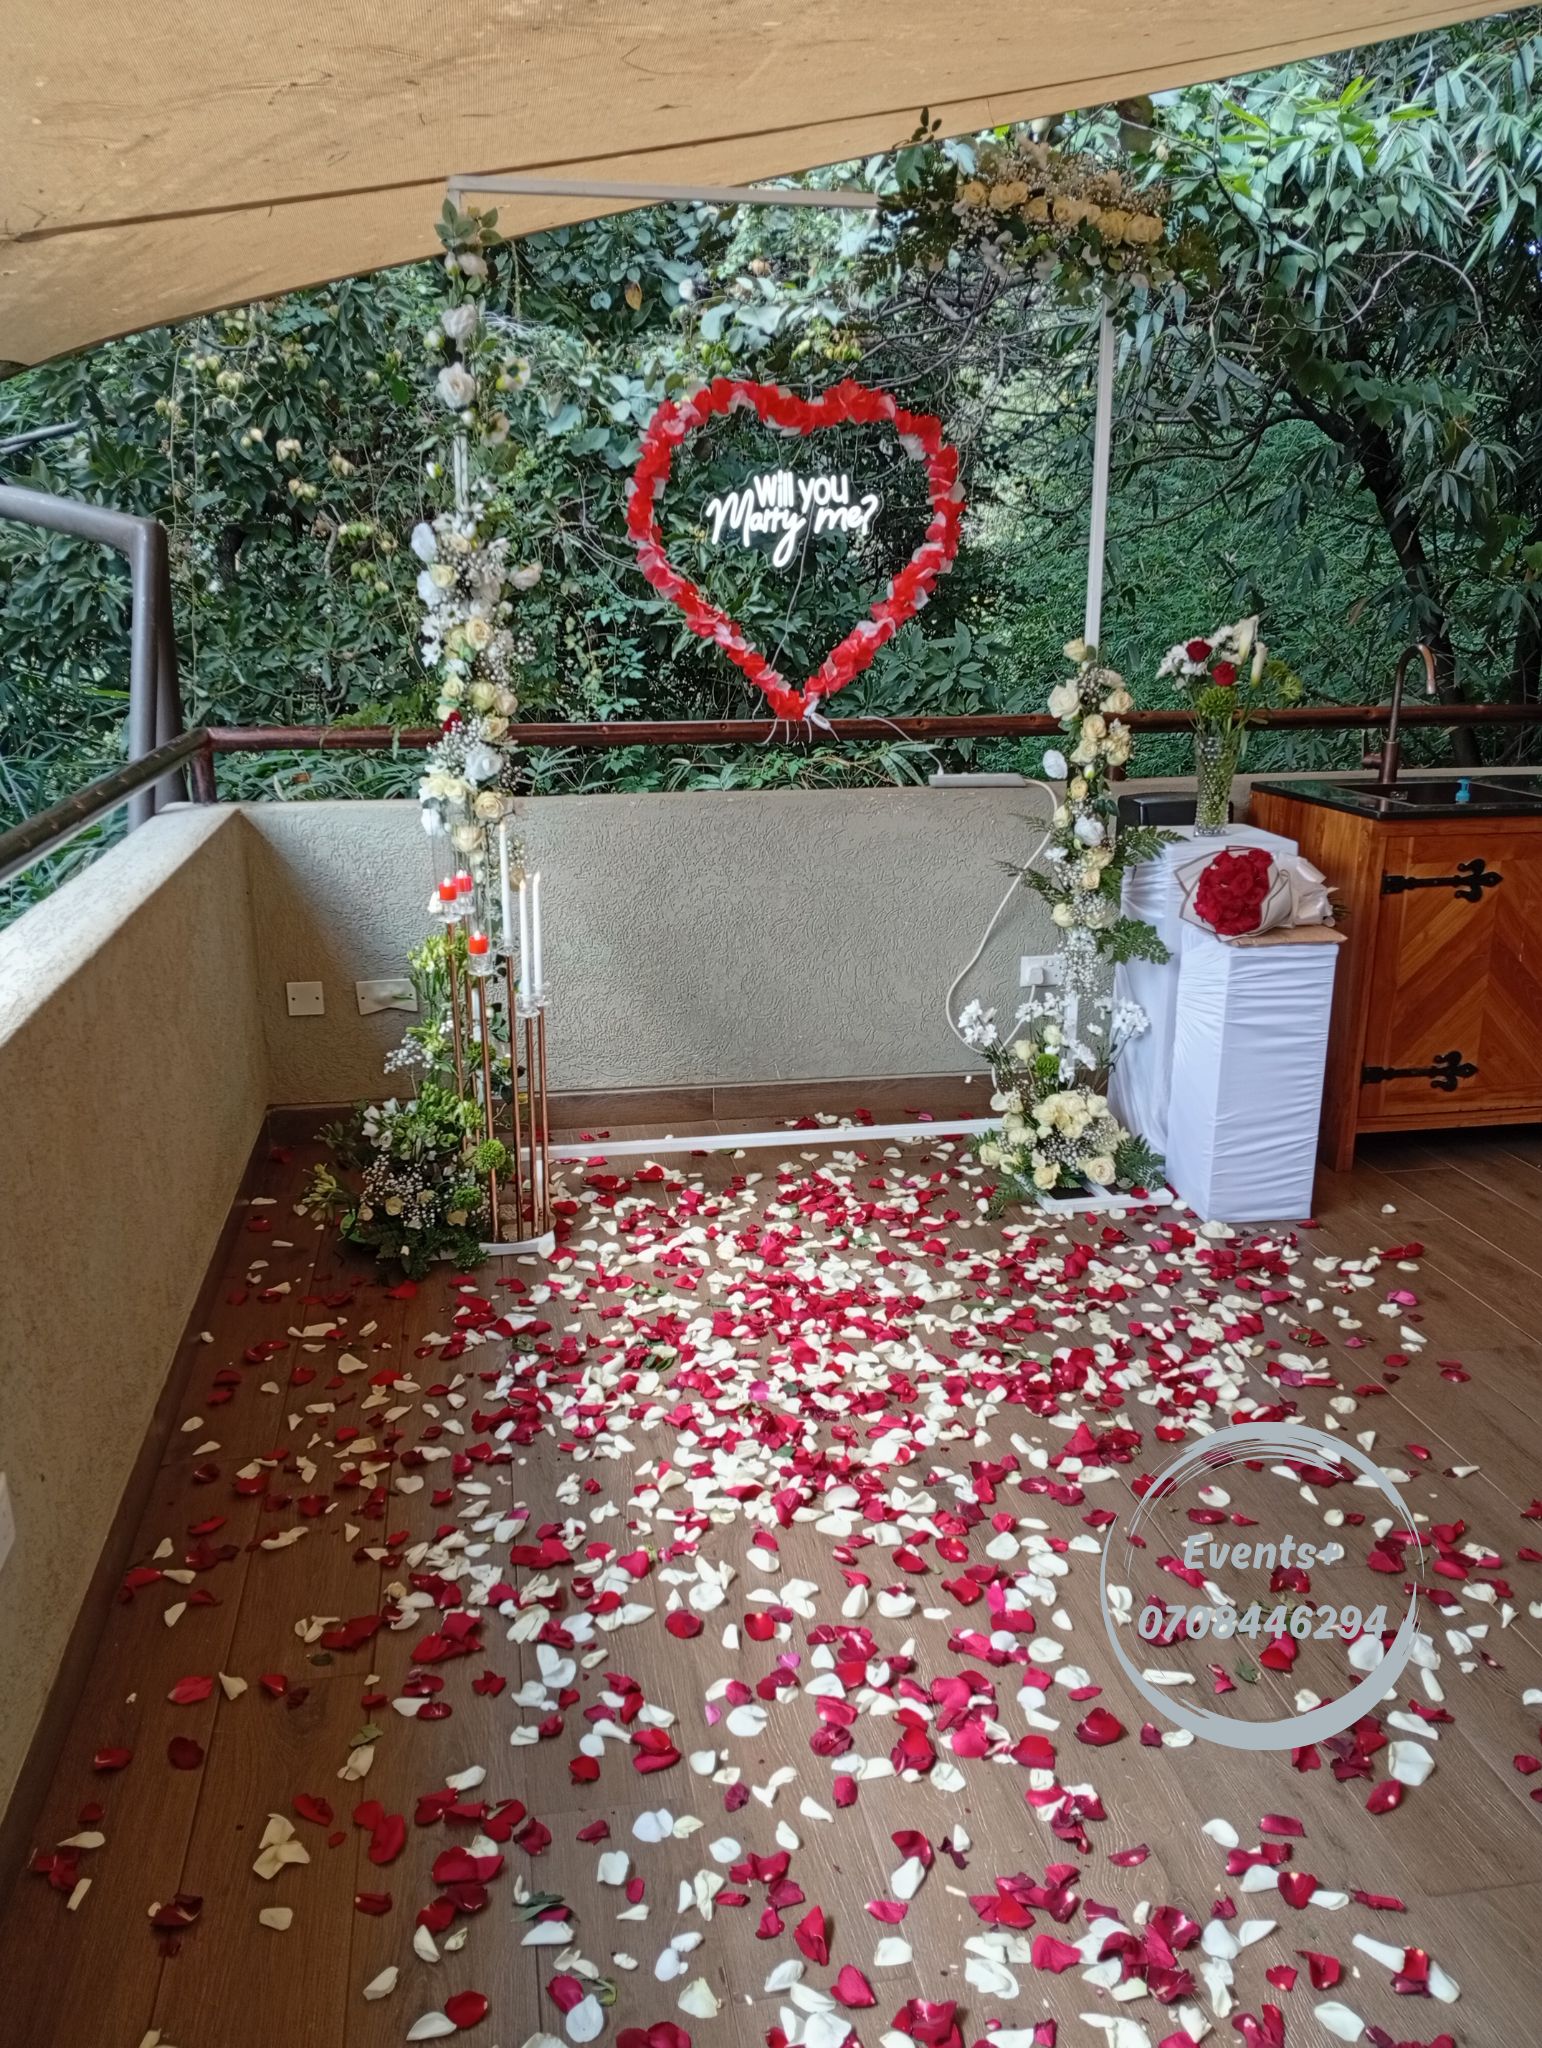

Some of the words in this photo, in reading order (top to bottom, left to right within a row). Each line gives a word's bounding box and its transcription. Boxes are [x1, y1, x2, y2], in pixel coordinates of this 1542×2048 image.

[753, 469, 794, 508] Will
[798, 474, 849, 514] you
[705, 488, 806, 568] Marry
[813, 494, 879, 535] me?
